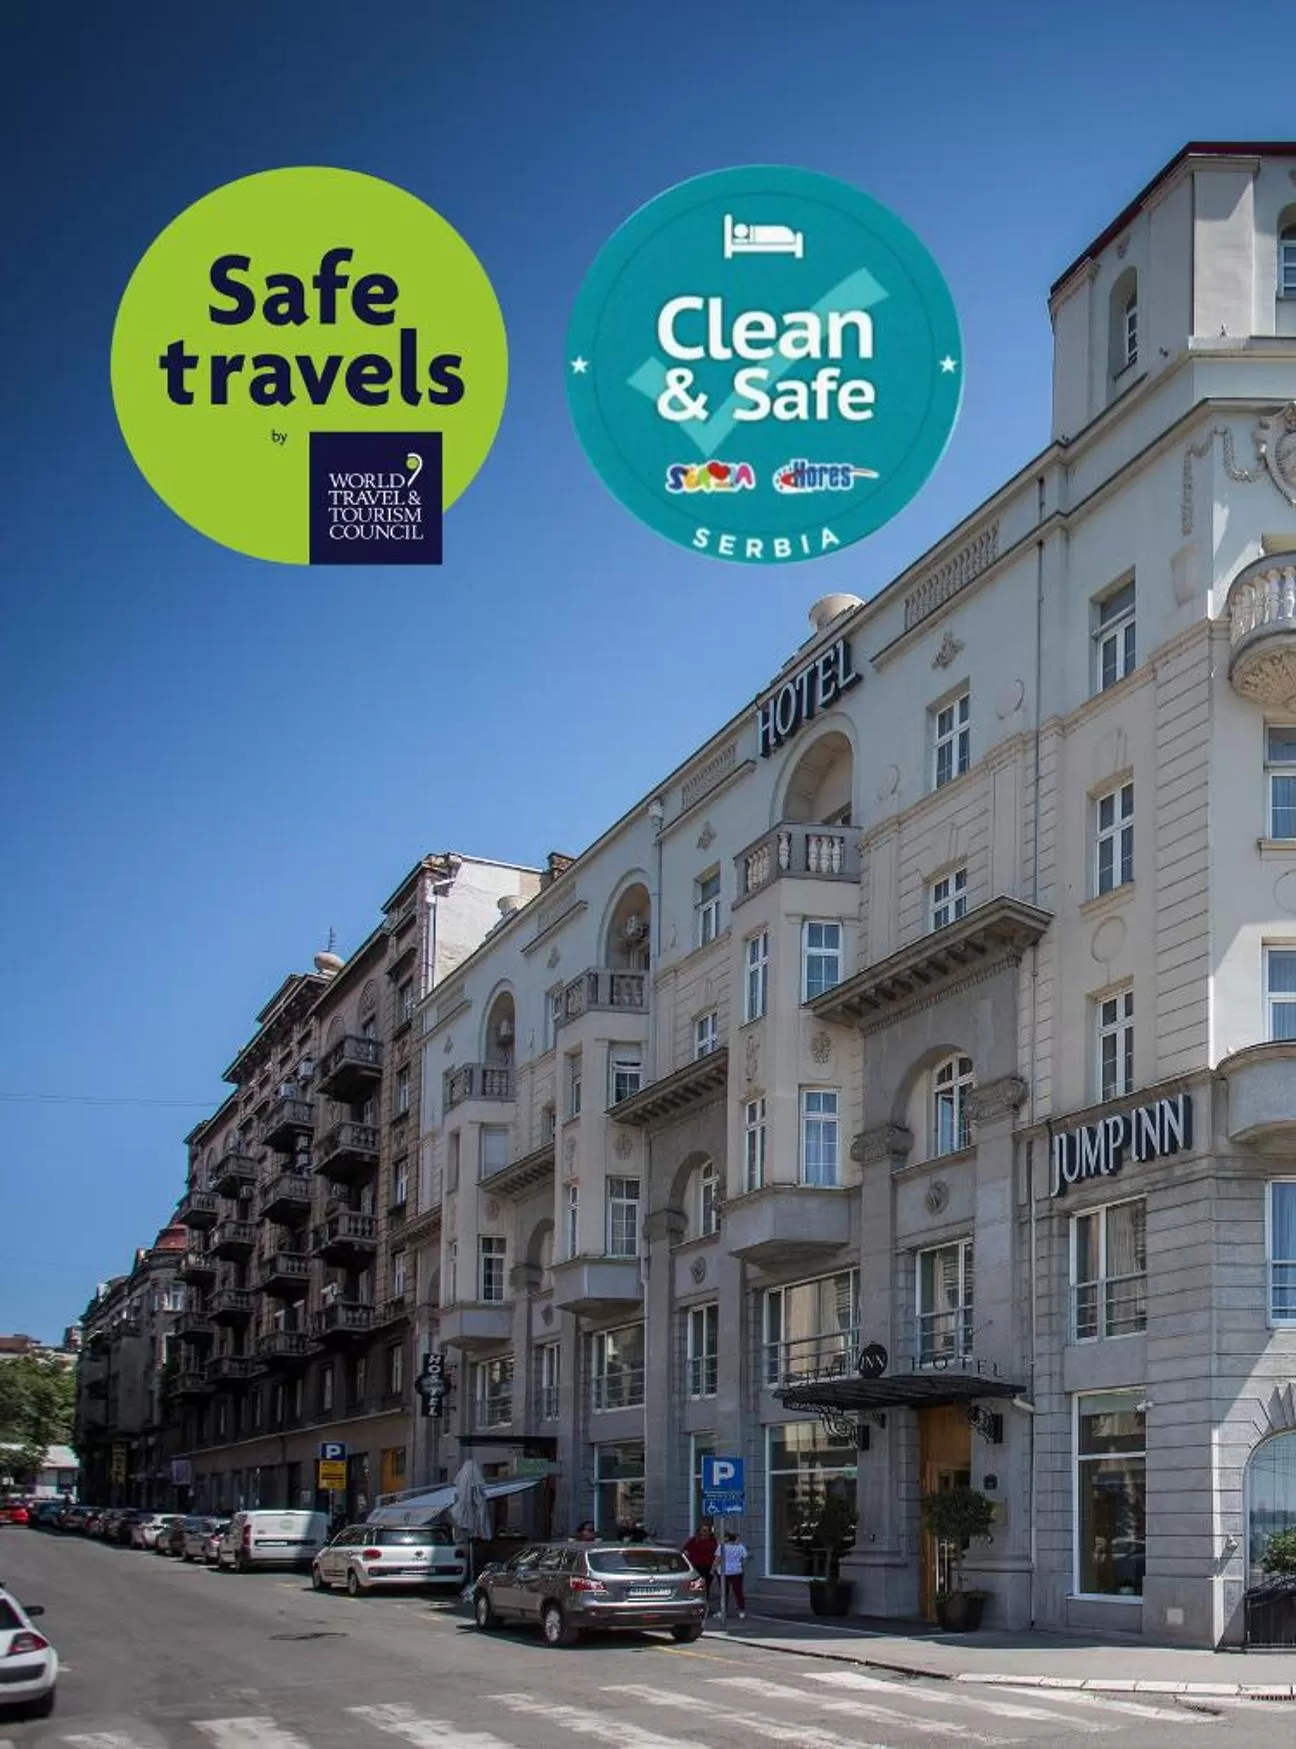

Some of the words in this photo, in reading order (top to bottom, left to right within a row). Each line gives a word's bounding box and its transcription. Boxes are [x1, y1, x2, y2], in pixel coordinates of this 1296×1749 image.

[756, 639, 857, 757] HOTEL
[1050, 1114, 1124, 1197] JUMP
[1131, 1093, 1184, 1162] INN
[911, 1354, 1002, 1377] HOTEL
[326, 1444, 341, 1459] P
[713, 1461, 736, 1486] P
